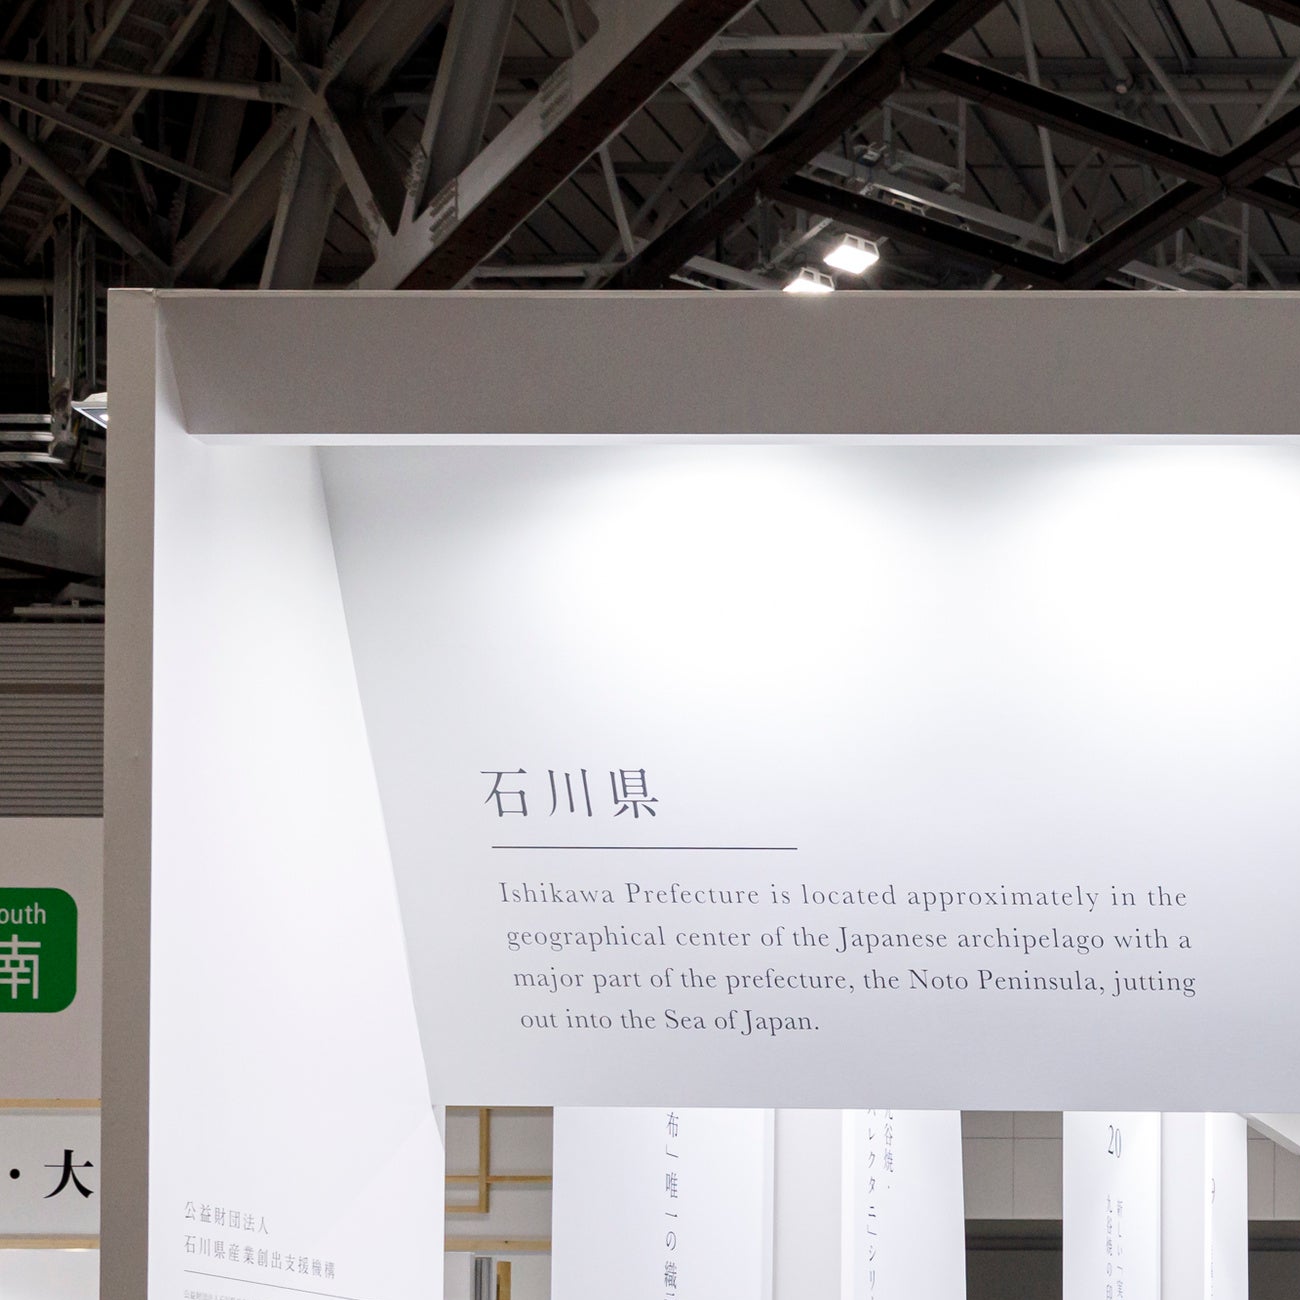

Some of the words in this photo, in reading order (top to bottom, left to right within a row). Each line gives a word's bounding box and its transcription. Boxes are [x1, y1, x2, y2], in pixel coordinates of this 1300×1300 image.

[480, 767, 659, 819] 石川県
[498, 881, 616, 905] Ishikawa
[623, 880, 760, 905] Prefecture
[770, 883, 791, 905] is
[801, 882, 897, 906] located
[907, 884, 1100, 913] approximately
[1111, 885, 1137, 907] in
[1147, 885, 1188, 907] the
[506, 924, 667, 953] geographical
[675, 930, 752, 947] center
[760, 925, 786, 947] of
[791, 926, 830, 948] the
[835, 926, 948, 955] Japanese
[957, 927, 1105, 956] archipelago
[1112, 927, 1169, 953] with
[1178, 935, 1193, 950] a
[0, 933, 41, 1000] 南
[513, 966, 585, 994] major
[591, 971, 643, 995] part
[649, 967, 675, 989] of
[679, 967, 718, 991] the
[724, 967, 855, 996] prefecture,
[862, 968, 901, 990] the
[907, 968, 969, 991] Noto
[976, 968, 1105, 996] Peninsula,
[1111, 969, 1197, 998] jutting
[520, 1012, 559, 1029] out
[565, 1008, 613, 1030] into
[619, 1008, 657, 1032] the
[664, 1008, 708, 1031] Sea
[714, 1009, 737, 1031] of
[739, 1009, 821, 1037] Japan.
[1107, 1124, 1123, 1159] 20
[184, 1200, 270, 1235] 公益財団法人
[184, 1234, 336, 1280] 石川県産業創出支援機構
